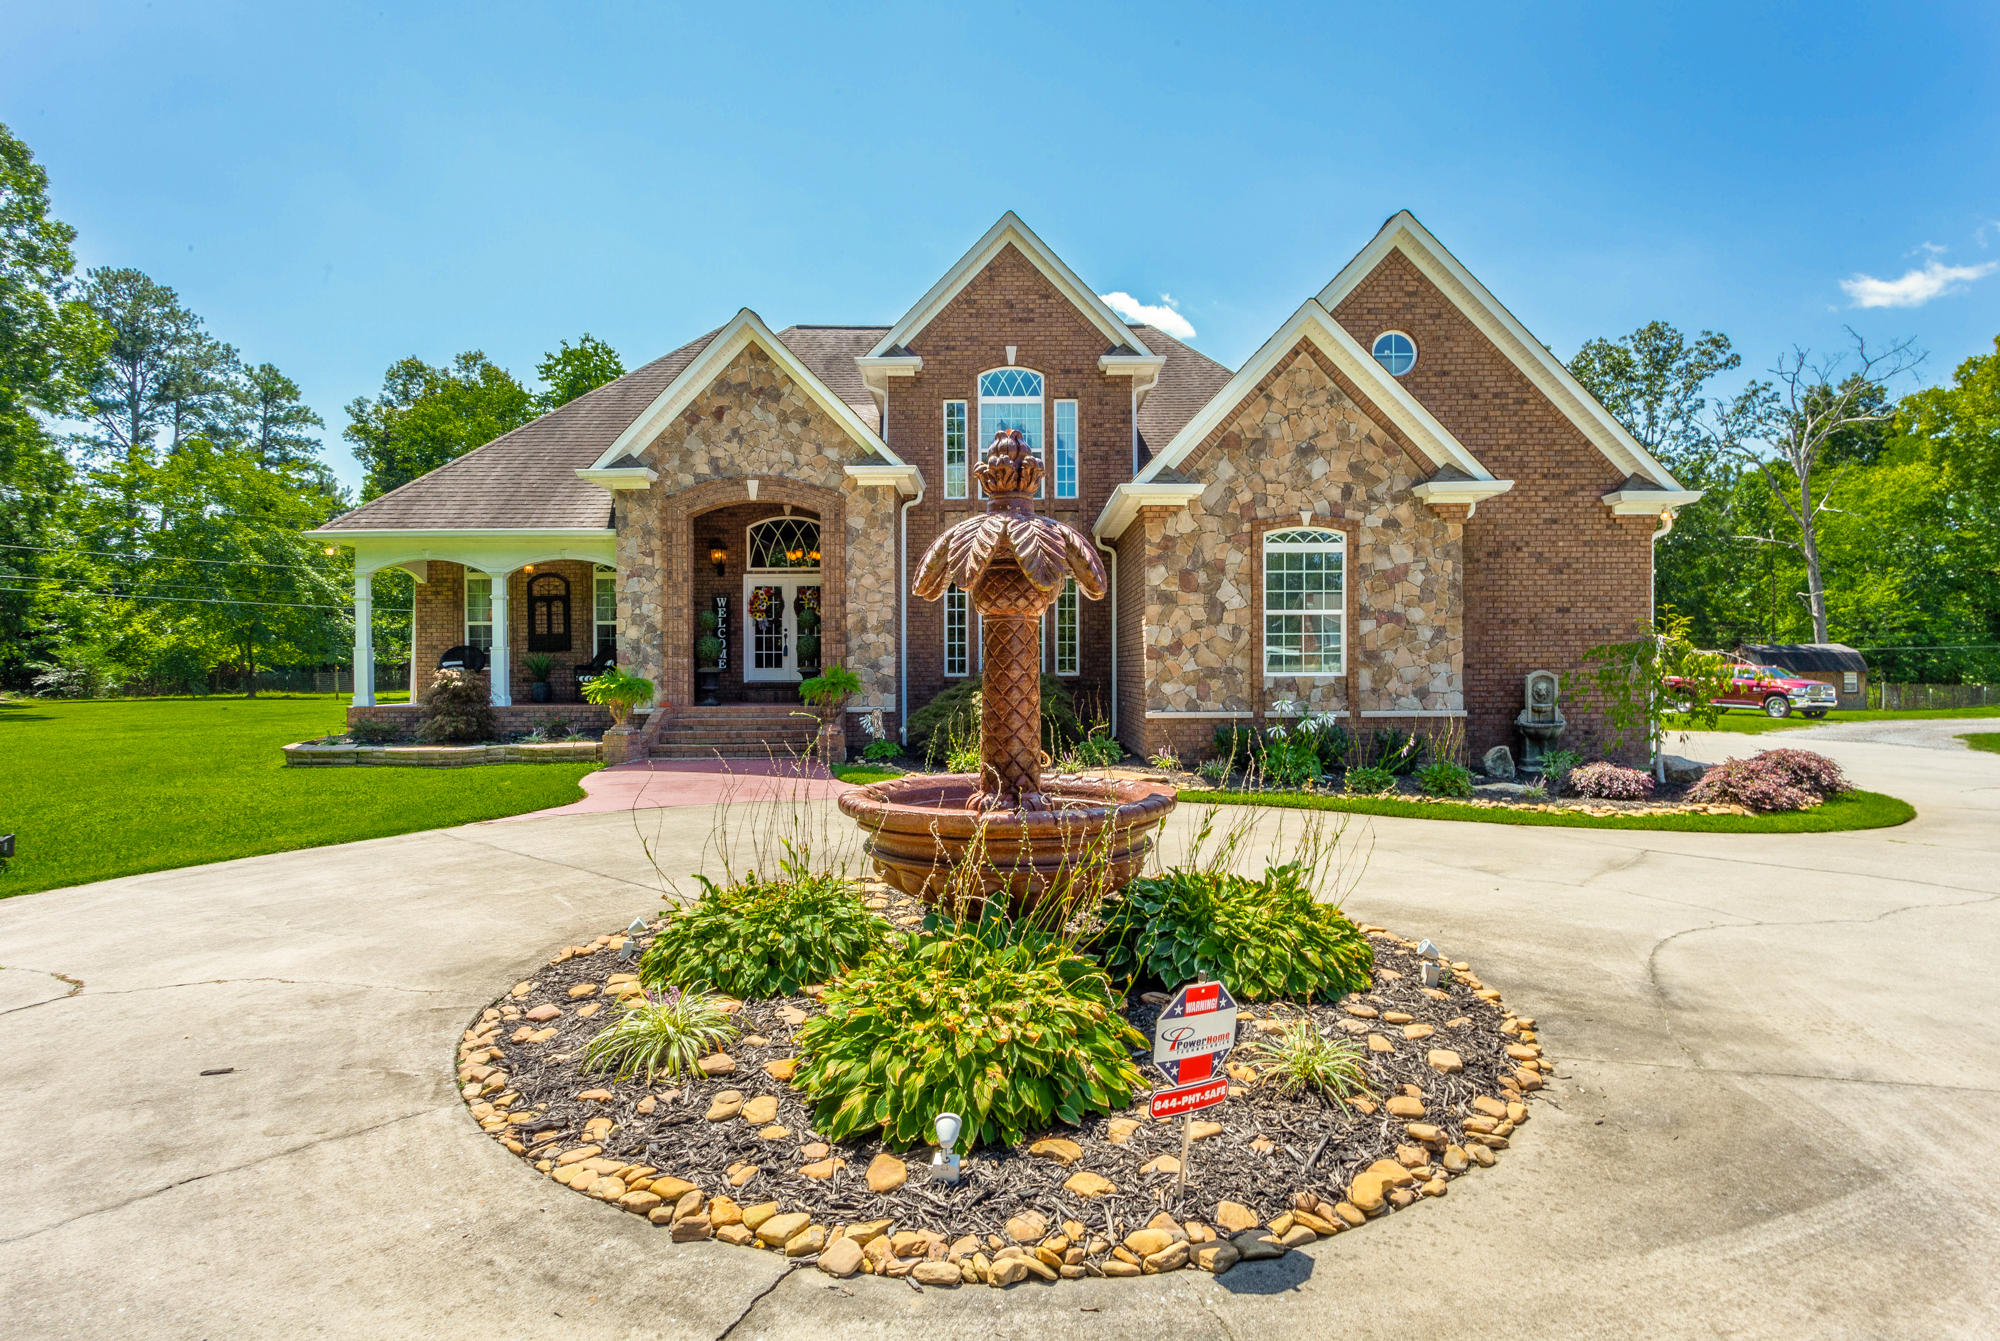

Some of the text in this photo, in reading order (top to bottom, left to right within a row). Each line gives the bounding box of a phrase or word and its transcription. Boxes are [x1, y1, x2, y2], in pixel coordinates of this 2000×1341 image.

[1185, 998, 1218, 1013] WARNING!
[1176, 1032, 1231, 1050] PowerHome
[1154, 1085, 1226, 1111] 844-PHT-SAFE
